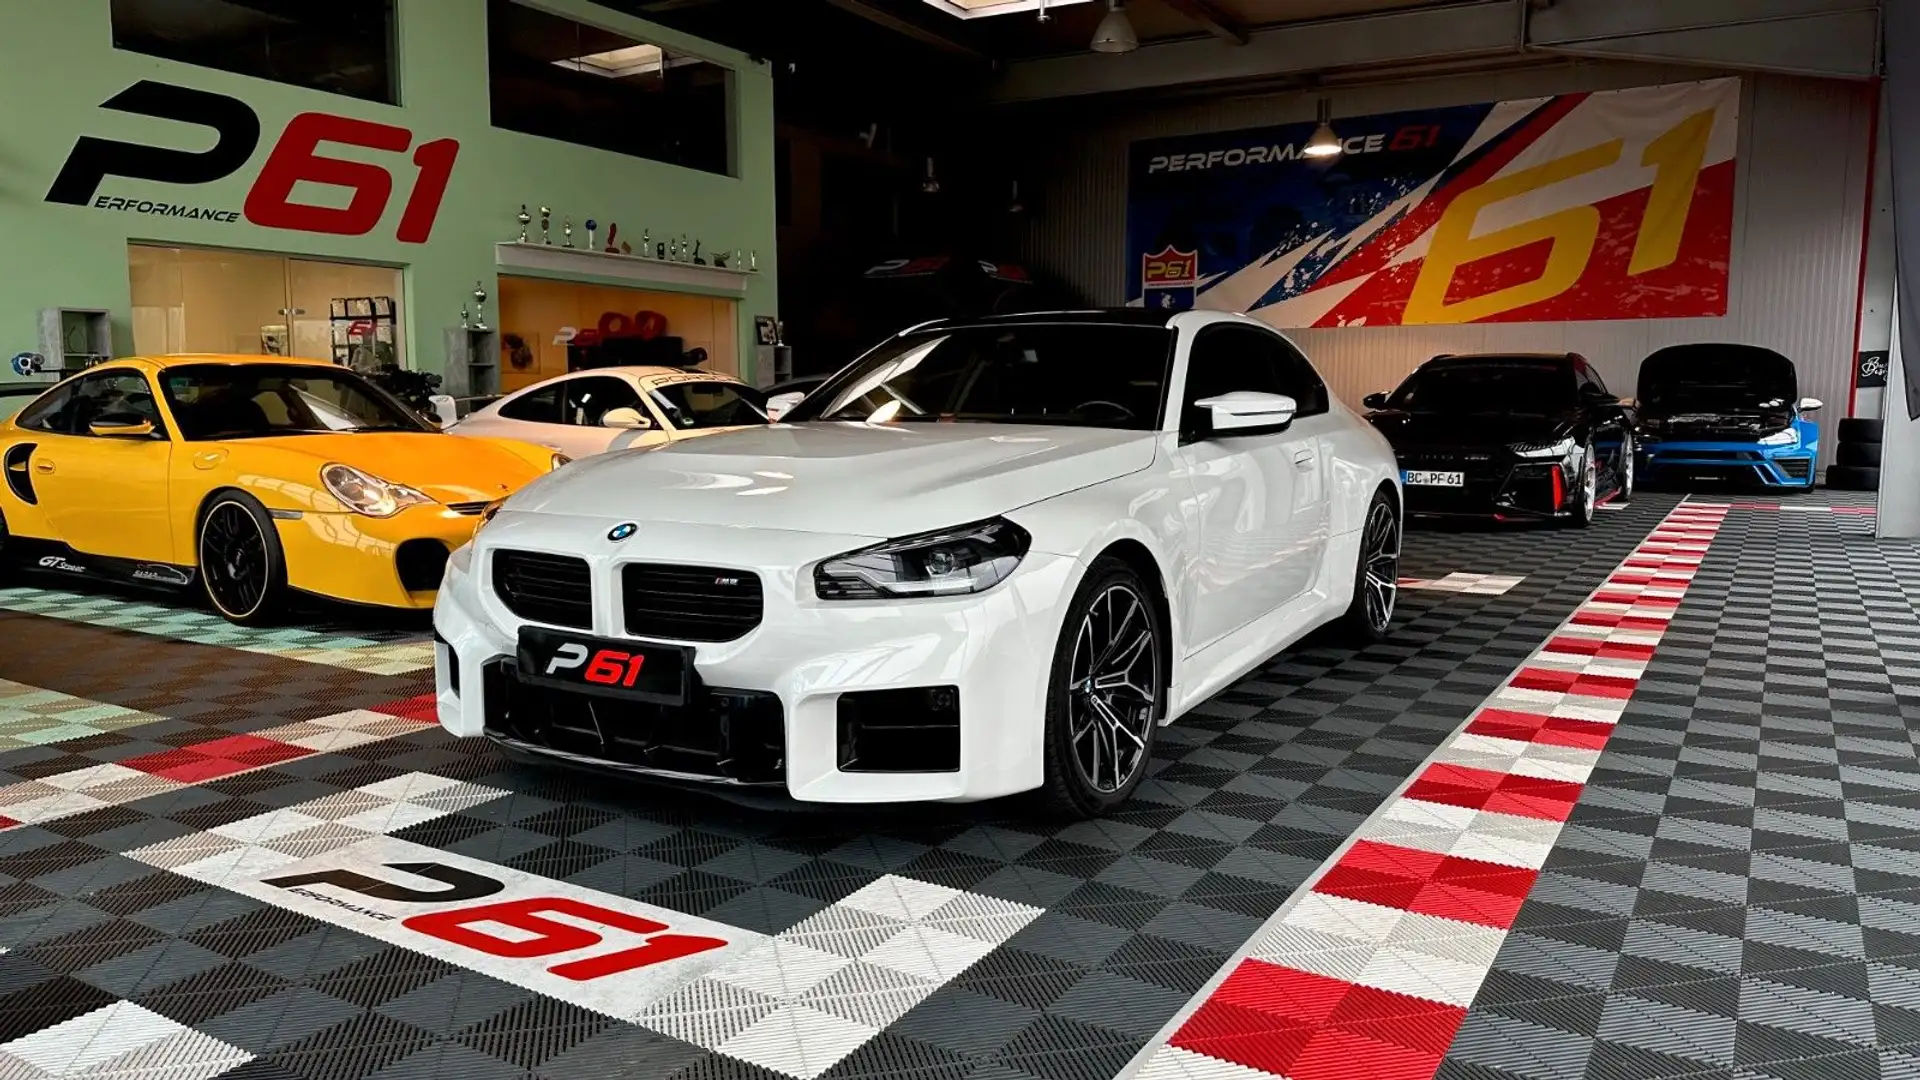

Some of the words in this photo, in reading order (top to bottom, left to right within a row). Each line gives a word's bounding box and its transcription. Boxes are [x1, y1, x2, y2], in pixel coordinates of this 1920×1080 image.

[44, 79, 460, 244] P61
[1148, 133, 1386, 174] PERFORMCE
[1388, 124, 1443, 153] 61
[94, 195, 241, 224] ERFORMANCE
[1401, 107, 1717, 324] 61
[1146, 259, 1193, 279] P61
[1407, 472, 1422, 483] BC
[1430, 473, 1445, 484] PF
[1447, 473, 1462, 485] 61
[39, 556, 67, 568] GT
[545, 642, 645, 688] P61
[260, 862, 730, 982] P61
